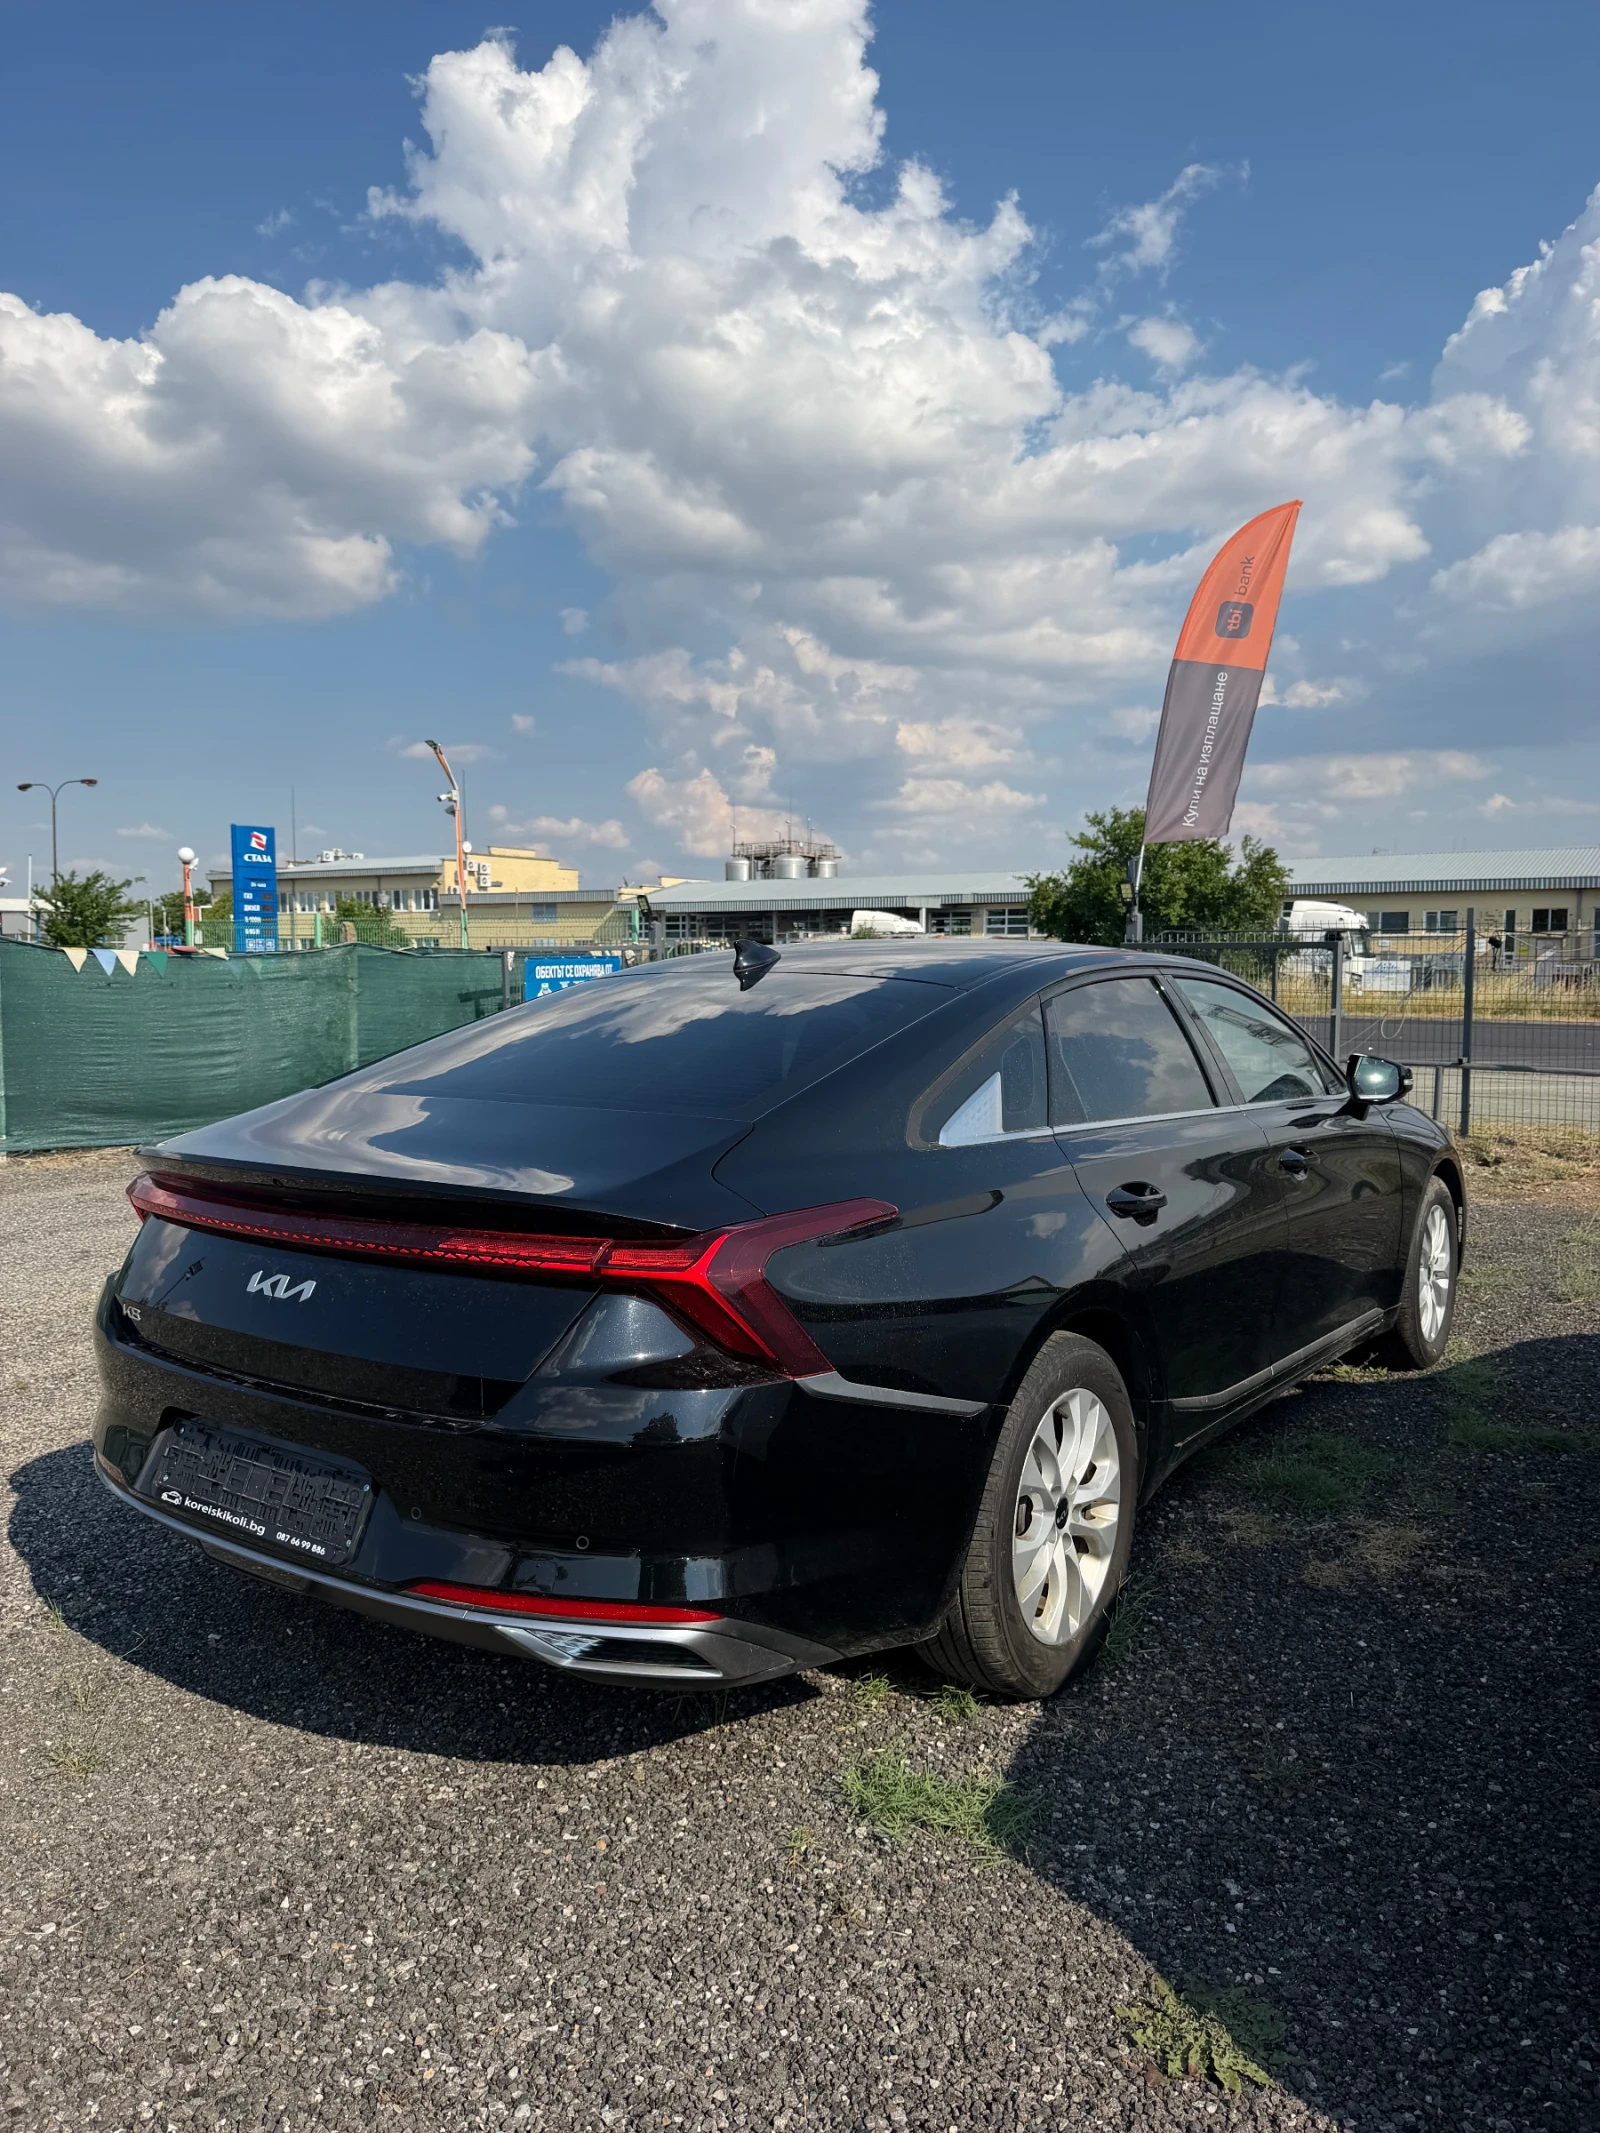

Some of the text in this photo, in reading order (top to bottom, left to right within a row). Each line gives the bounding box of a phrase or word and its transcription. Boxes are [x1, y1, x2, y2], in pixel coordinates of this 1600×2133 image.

[1228, 556, 1255, 631] tbi bank
[1182, 672, 1228, 827] Купи на изплащане
[244, 854, 272, 863] СТАЗА
[536, 964, 612, 979] ОБЕКТЪТ СЕ ОХРАНЯВА ОТ
[184, 1496, 266, 1536] koreiskikoli.bg
[276, 1532, 326, 1556] 087 66 99 886
